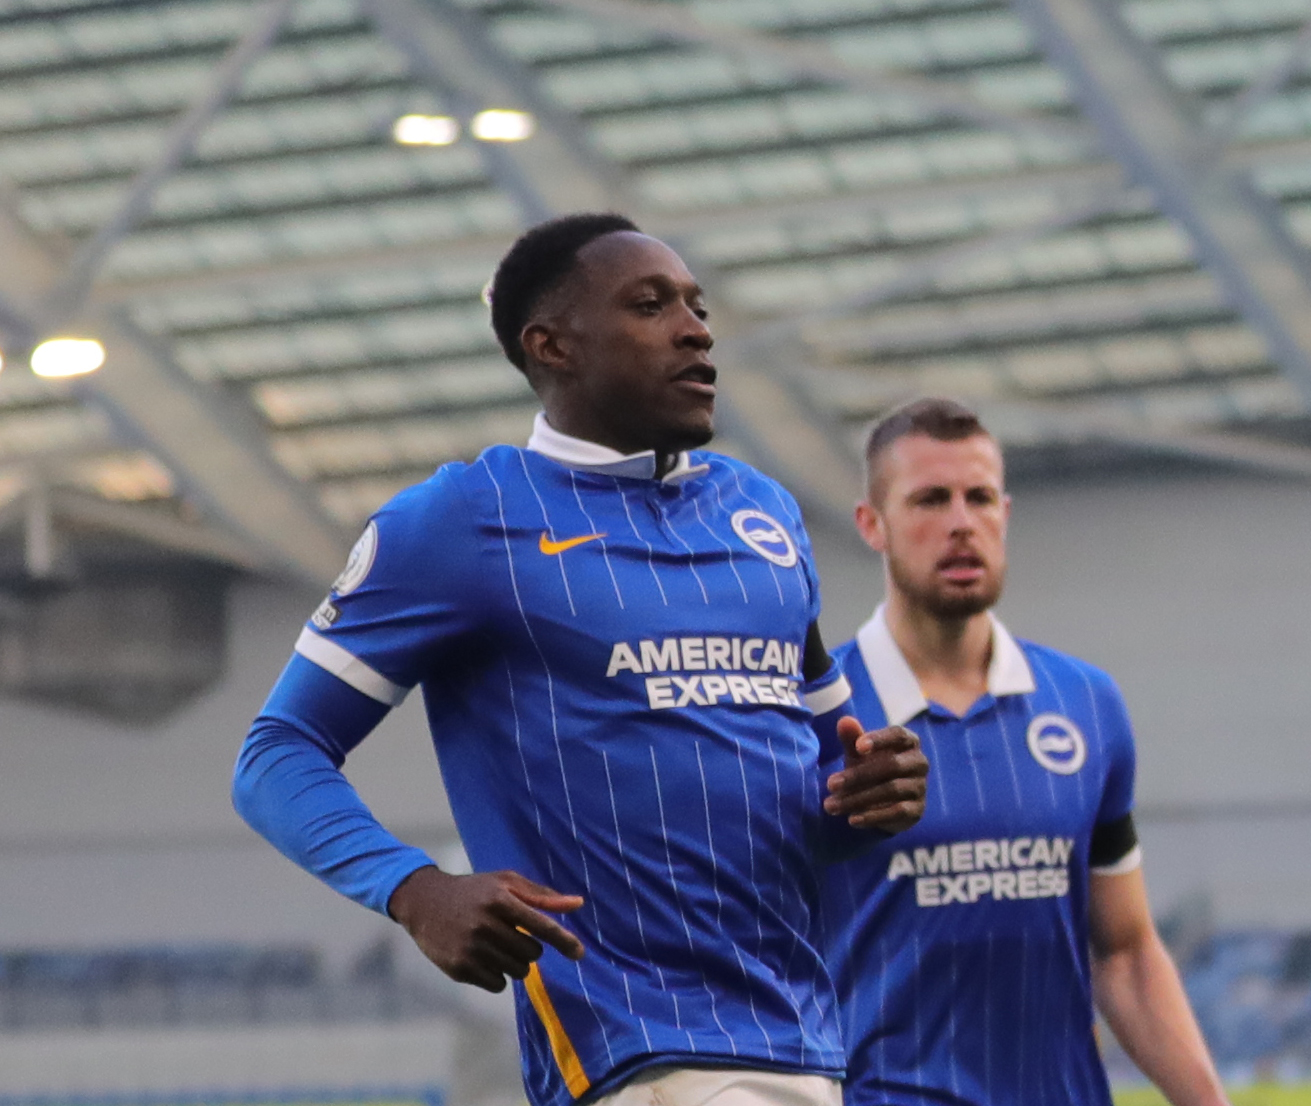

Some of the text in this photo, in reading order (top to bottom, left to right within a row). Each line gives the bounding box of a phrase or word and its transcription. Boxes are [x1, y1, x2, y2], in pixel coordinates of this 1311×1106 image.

[606, 637, 799, 678] AMERICAN
[645, 675, 801, 710] EXPRESS
[888, 835, 1075, 881] AMERICAN
[914, 867, 1070, 907] EXPRESS
